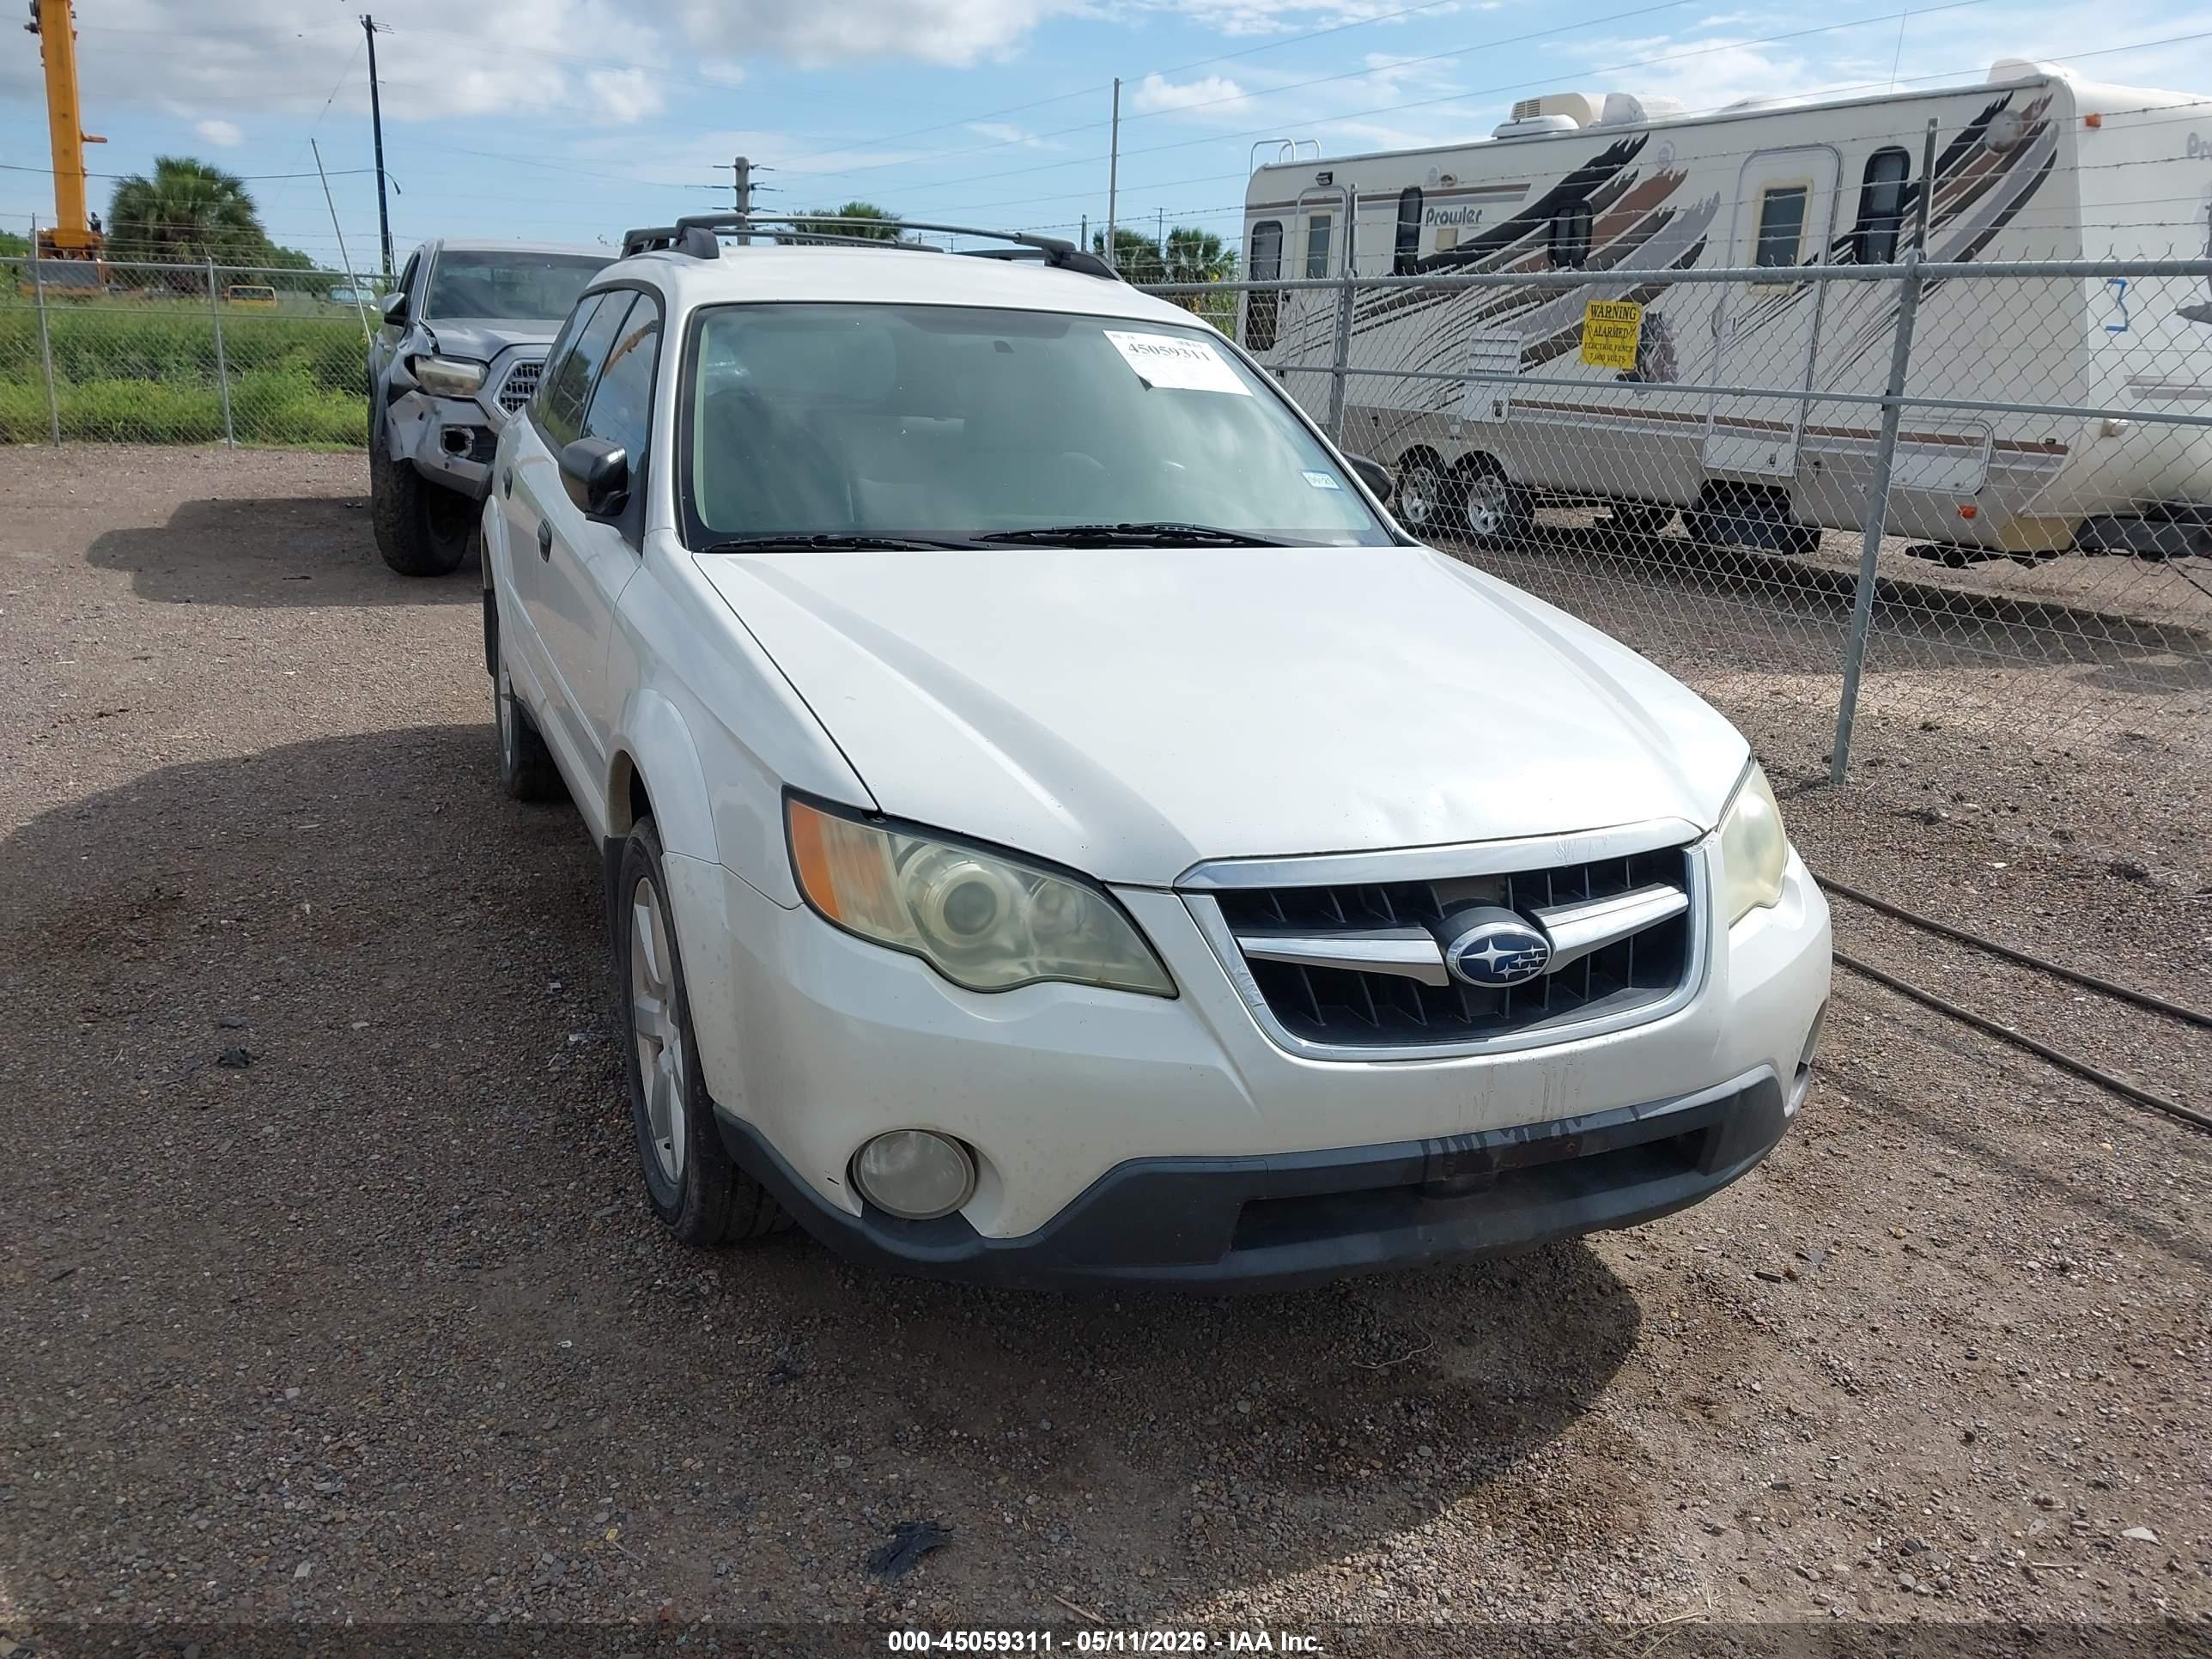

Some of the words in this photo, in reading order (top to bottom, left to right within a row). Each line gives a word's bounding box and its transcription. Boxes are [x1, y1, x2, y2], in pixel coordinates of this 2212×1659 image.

[1425, 206, 1482, 226] Prowler
[1590, 304, 1637, 320] WARNING
[2106, 278, 2129, 332] 3
[1593, 325, 1629, 338] ALARMED
[1128, 343, 1212, 361] 45059311
[1614, 344, 1635, 353] FENCE
[1607, 354, 1626, 362] VOLTS
